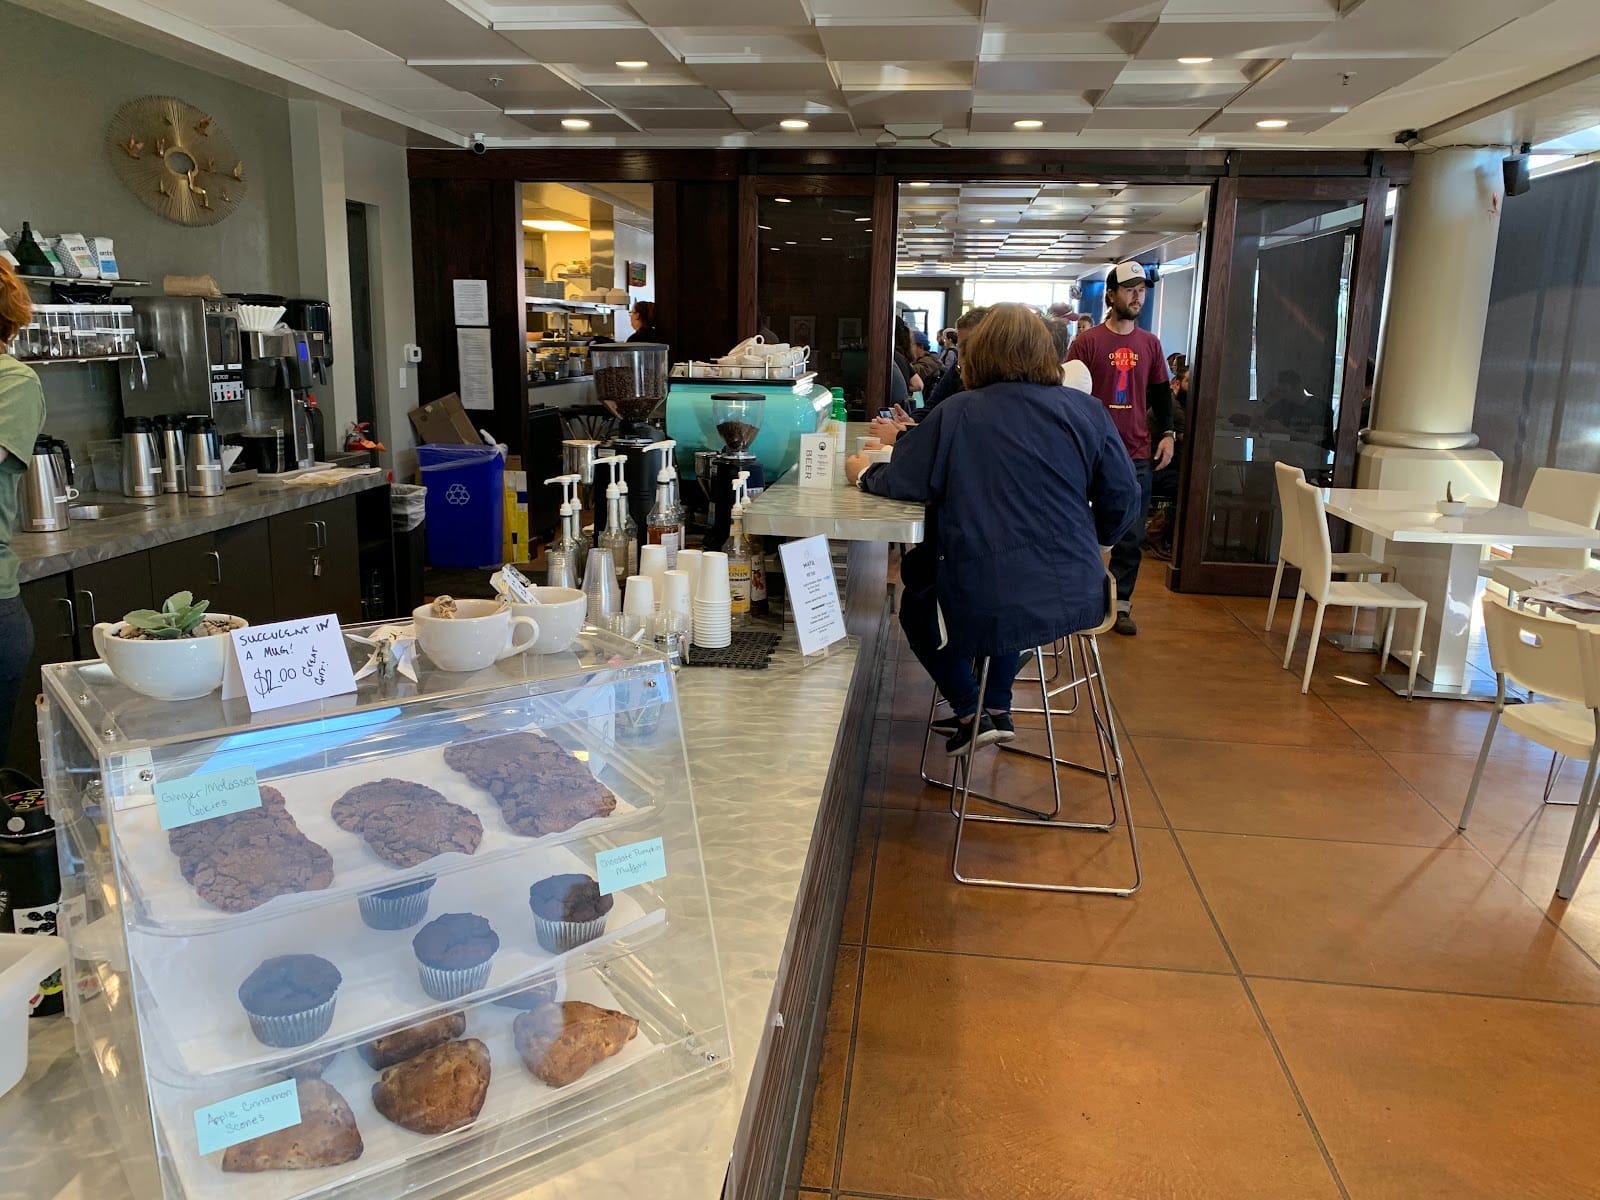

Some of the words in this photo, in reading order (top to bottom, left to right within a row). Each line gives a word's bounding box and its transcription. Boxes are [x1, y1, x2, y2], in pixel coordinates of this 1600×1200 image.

[805, 449, 813, 480] BEER
[239, 626, 310, 646] SUCCULENT
[316, 618, 330, 632] IN
[246, 650, 253, 660] A
[264, 643, 294, 658] MUG!
[207, 1111, 238, 1126] Apple
[241, 1089, 293, 1112] Cinnamon
